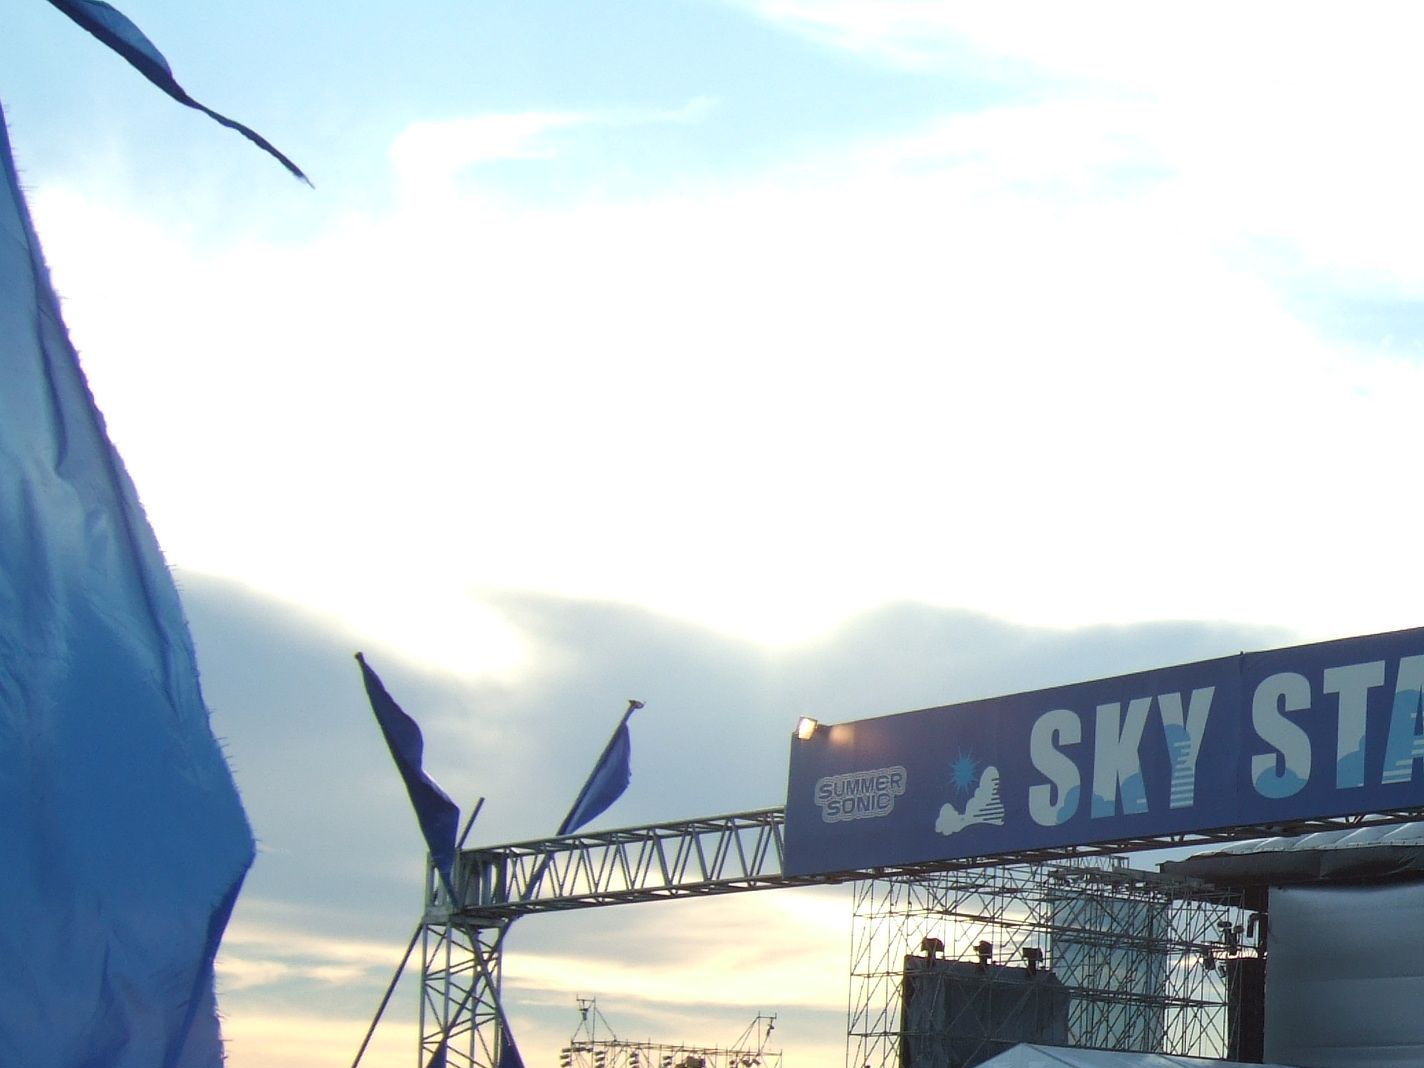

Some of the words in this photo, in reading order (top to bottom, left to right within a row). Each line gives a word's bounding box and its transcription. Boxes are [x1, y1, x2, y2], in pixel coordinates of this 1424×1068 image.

[1028, 686, 1216, 828] SKY
[818, 772, 903, 799] SUMMER
[826, 792, 891, 817] SONIC
